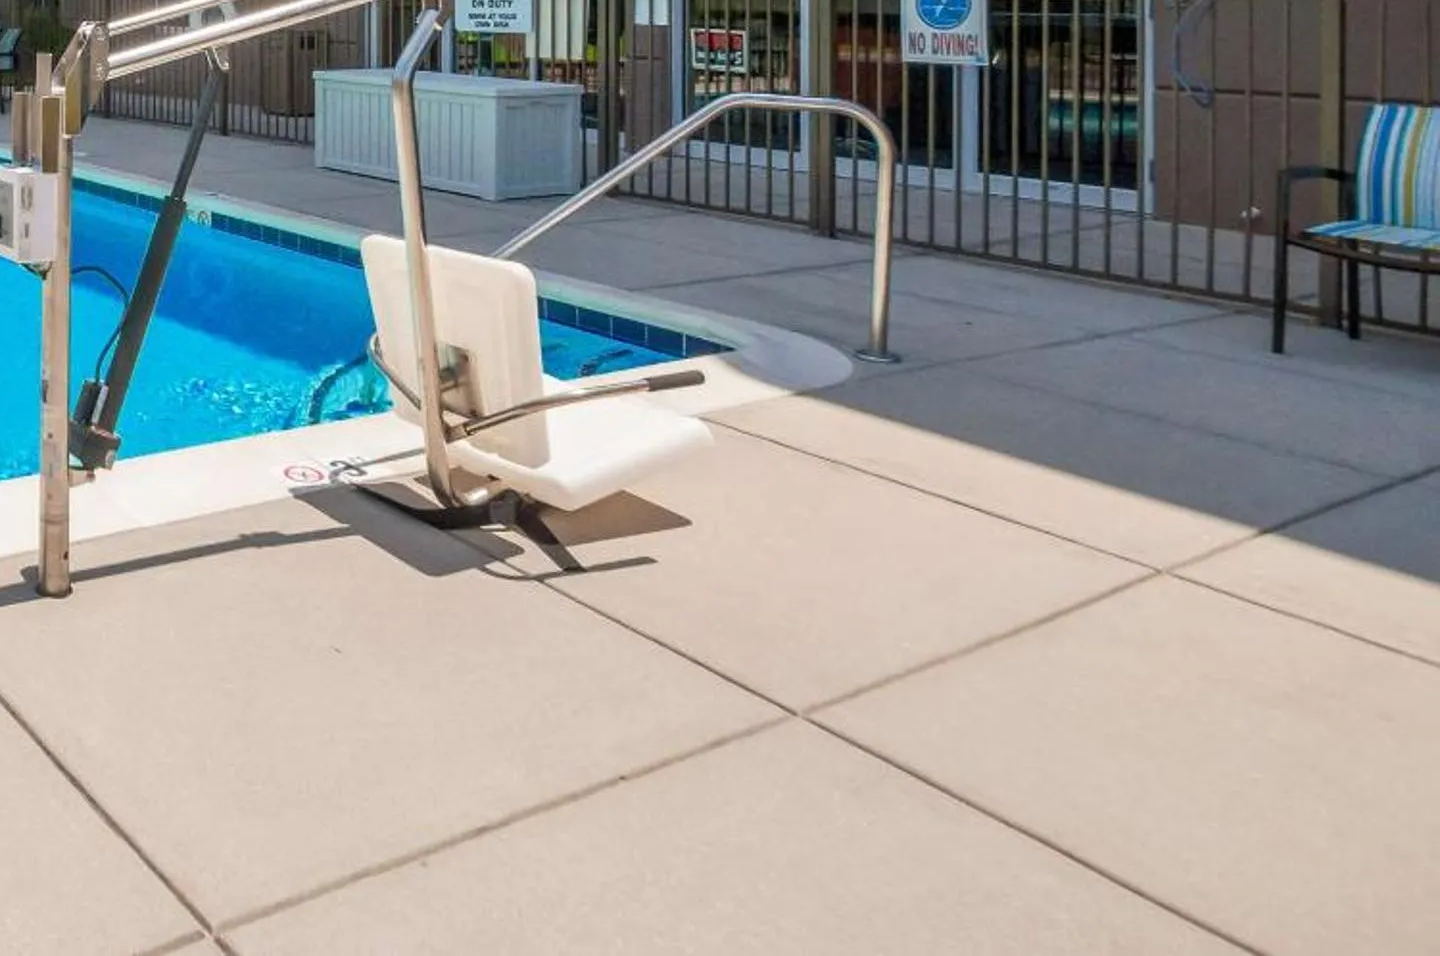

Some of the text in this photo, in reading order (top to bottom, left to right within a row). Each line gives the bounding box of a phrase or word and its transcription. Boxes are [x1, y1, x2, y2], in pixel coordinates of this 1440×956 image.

[471, 0, 513, 9] ON DUTY
[907, 32, 979, 57] NO DIVING!
